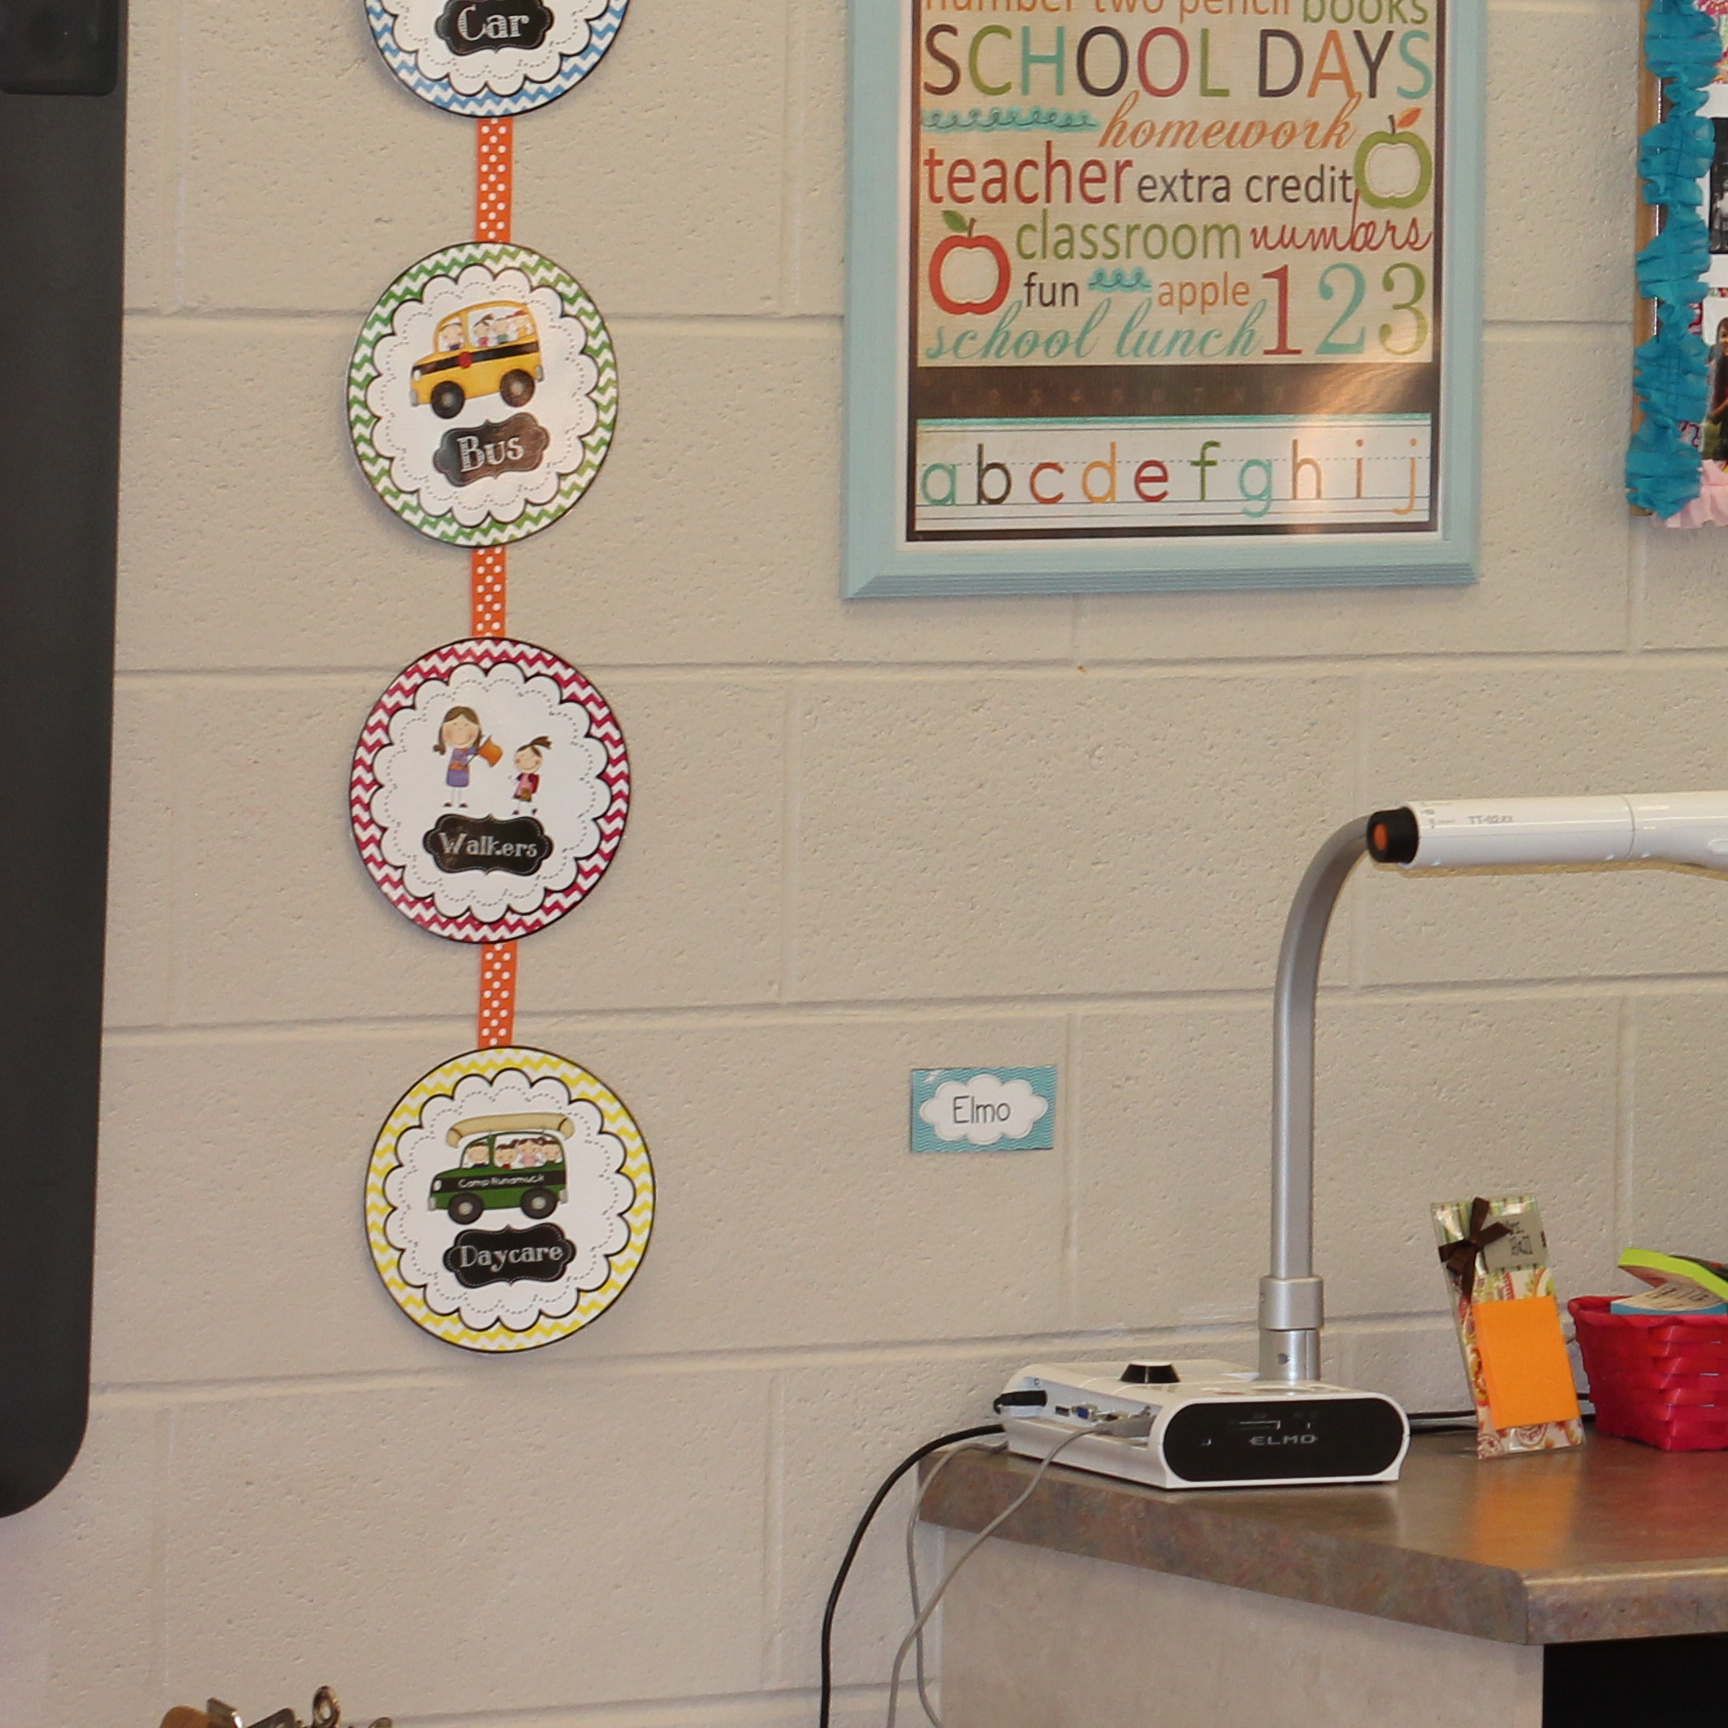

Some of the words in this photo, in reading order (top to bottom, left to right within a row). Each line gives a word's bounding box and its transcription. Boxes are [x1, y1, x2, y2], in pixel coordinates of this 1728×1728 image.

[457, 6, 530, 42] Car
[923, 23, 1230, 99] SCHOOL
[1257, 28, 1433, 100] DAYS
[1097, 90, 1358, 150] homework
[923, 140, 1133, 205] teacher
[1137, 166, 1232, 205] extra
[1245, 163, 1354, 205] credit
[1016, 209, 1242, 262] classroom
[1250, 188, 1433, 253] numbers
[1024, 271, 1081, 308] fun
[1157, 271, 1251, 315] apple
[925, 300, 1113, 360] school
[1115, 298, 1268, 359] lunch
[456, 435, 524, 474] Bus
[438, 832, 539, 859] Walkers
[953, 1094, 1012, 1125] Elmo
[459, 1240, 565, 1273] Daycare
[1249, 1433, 1319, 1447] ELMO
